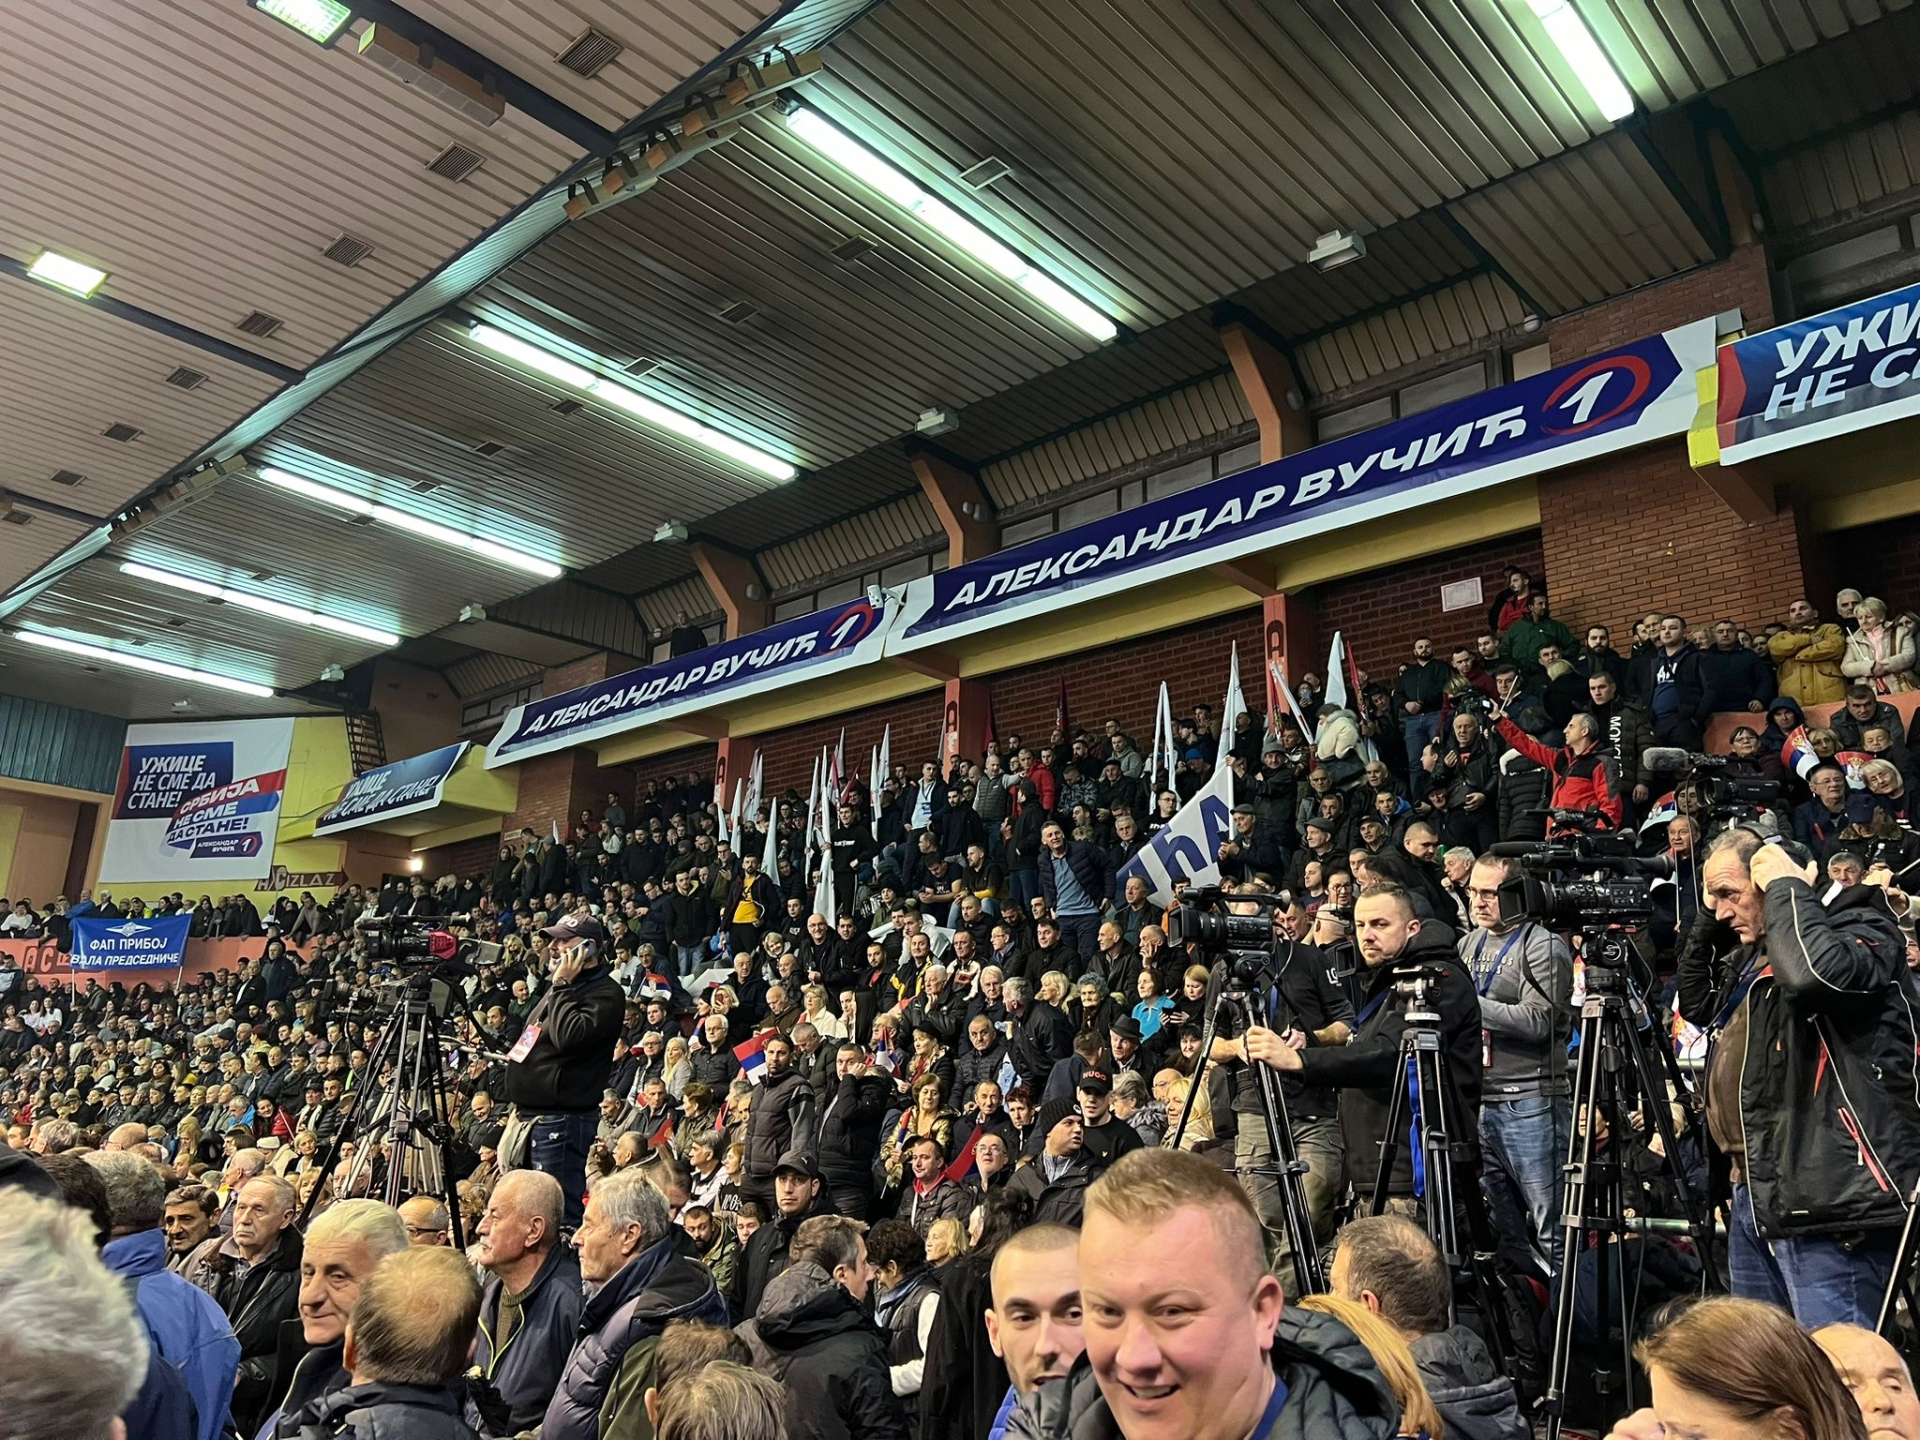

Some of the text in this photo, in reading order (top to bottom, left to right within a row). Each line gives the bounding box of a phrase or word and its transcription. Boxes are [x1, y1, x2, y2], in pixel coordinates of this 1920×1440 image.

[1764, 347, 1920, 422] НЕ С
[943, 371, 1613, 611] АЛЕКСАНДАР ВУЧИЋ 1
[521, 613, 860, 737] АЛЕКСАНДАР ВУЧИЋ 1
[139, 755, 206, 774] УЖИЦЕ
[133, 772, 216, 791] НЕ СМЕ ДА
[127, 791, 182, 809] СТАНЕ!
[180, 778, 260, 815] СРБИЈА
[173, 801, 238, 829] НЕ СМЕ
[167, 817, 249, 843] ДА СТАНЕ!
[197, 839, 238, 848] АЛЕКСАНДАР
[242, 838, 251, 852] 1
[286, 873, 335, 887] IZLAZ
[89, 937, 168, 950] ФАП ПРИБОЈ
[104, 952, 179, 966] ПРЕДСЕДНИЧЕ
